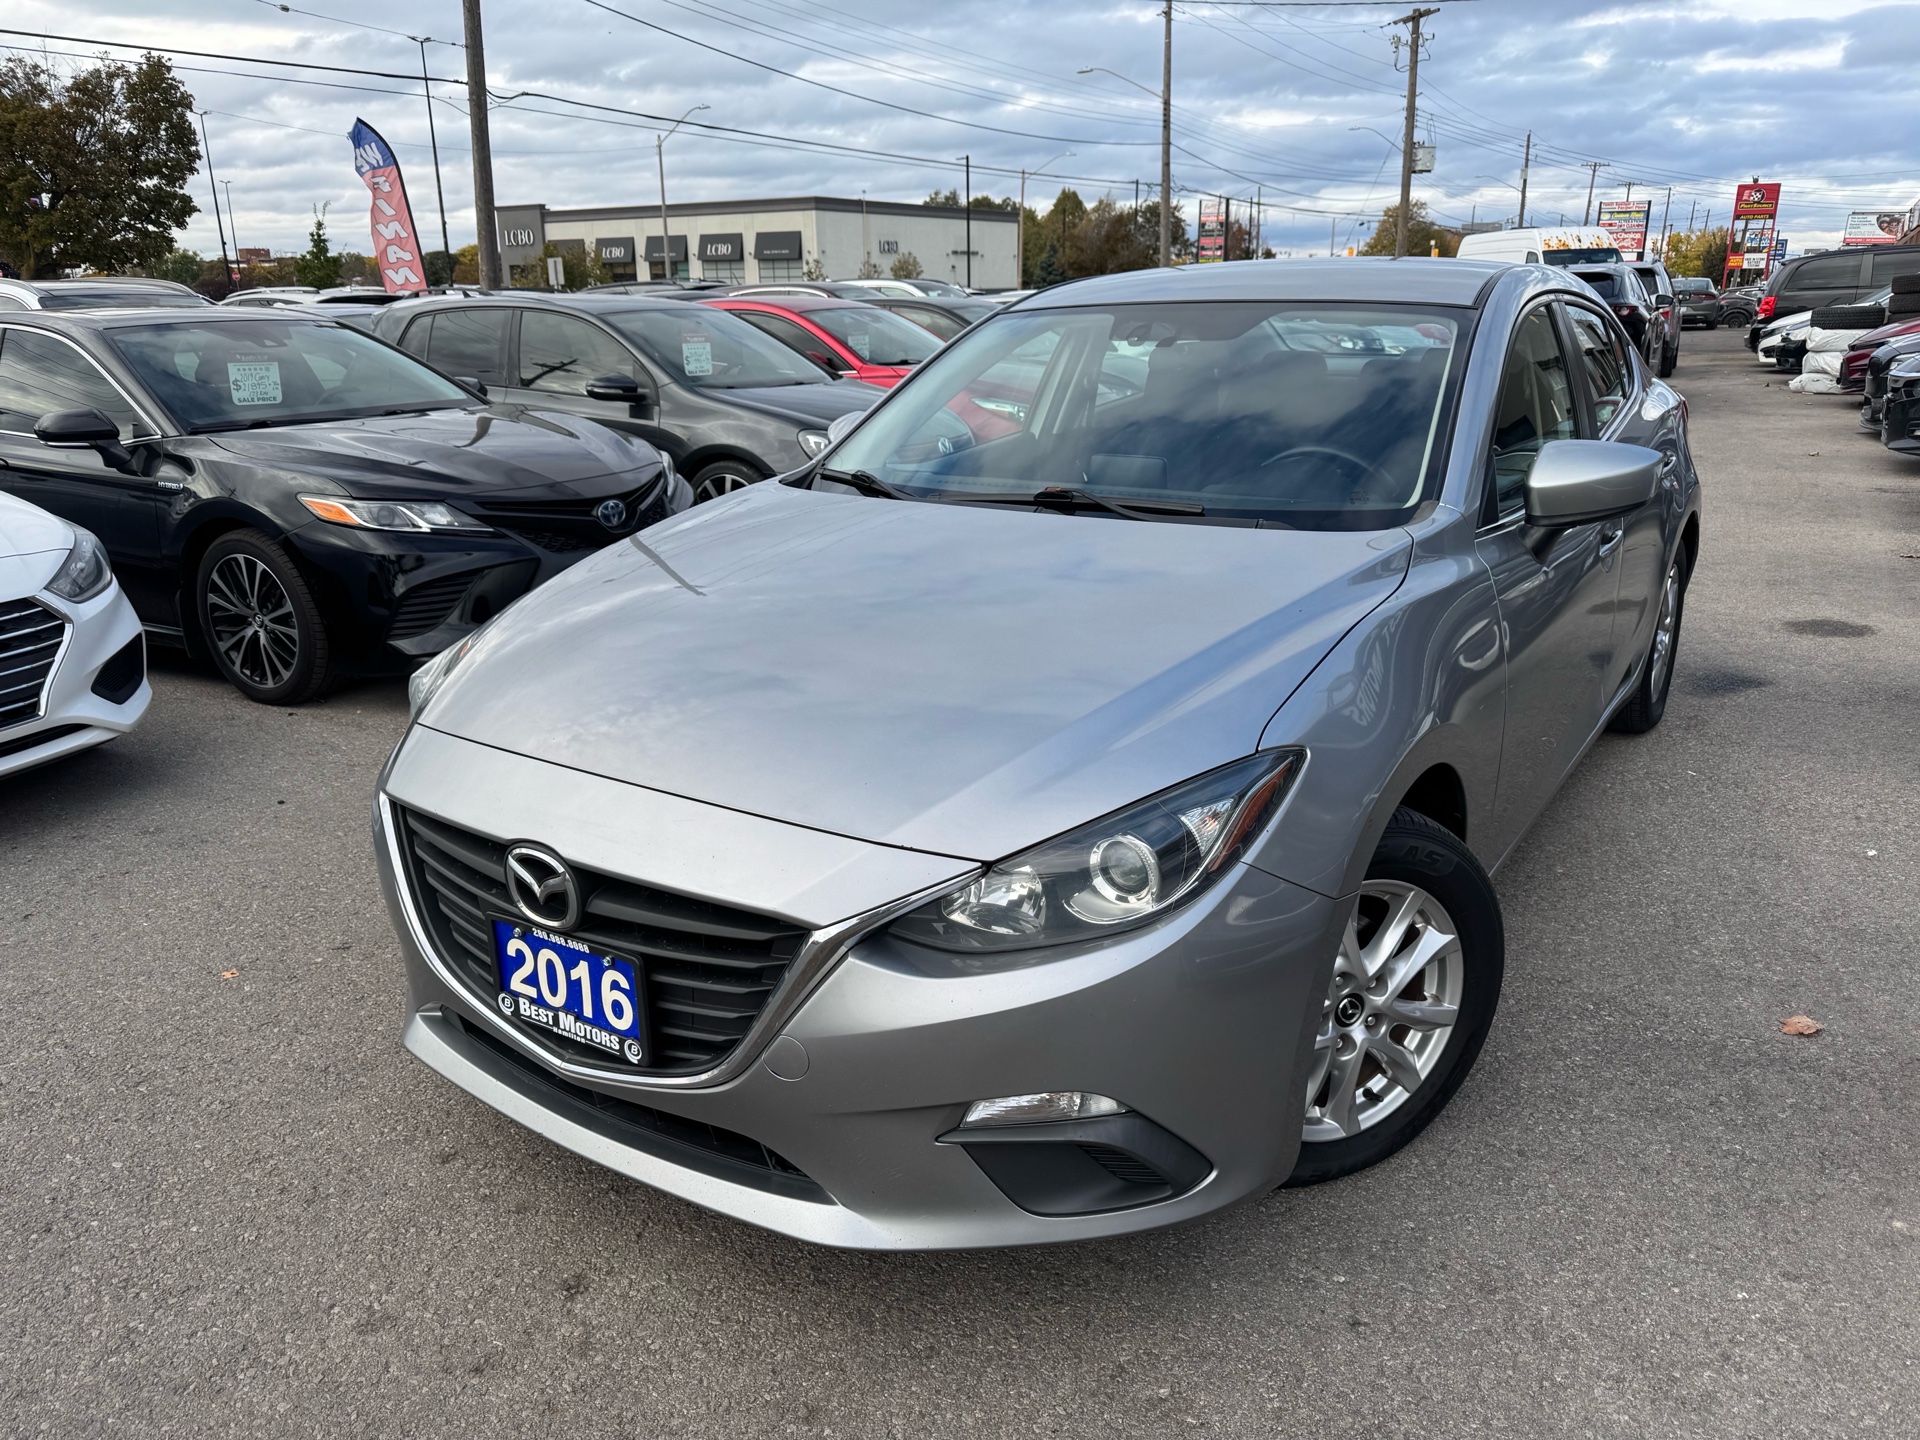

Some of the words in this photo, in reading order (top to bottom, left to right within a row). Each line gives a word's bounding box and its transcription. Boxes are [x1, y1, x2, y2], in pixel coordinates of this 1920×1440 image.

[504, 229, 534, 246] LCBO
[602, 246, 625, 259] LCBO
[706, 242, 732, 256] LCBO
[878, 239, 899, 254] LCBO
[158, 481, 180, 490] HYBRID
[506, 938, 634, 1031] 2016
[518, 996, 555, 1026] BEST
[558, 1010, 621, 1051] MOTORS
[552, 1026, 586, 1044] Hamilton
